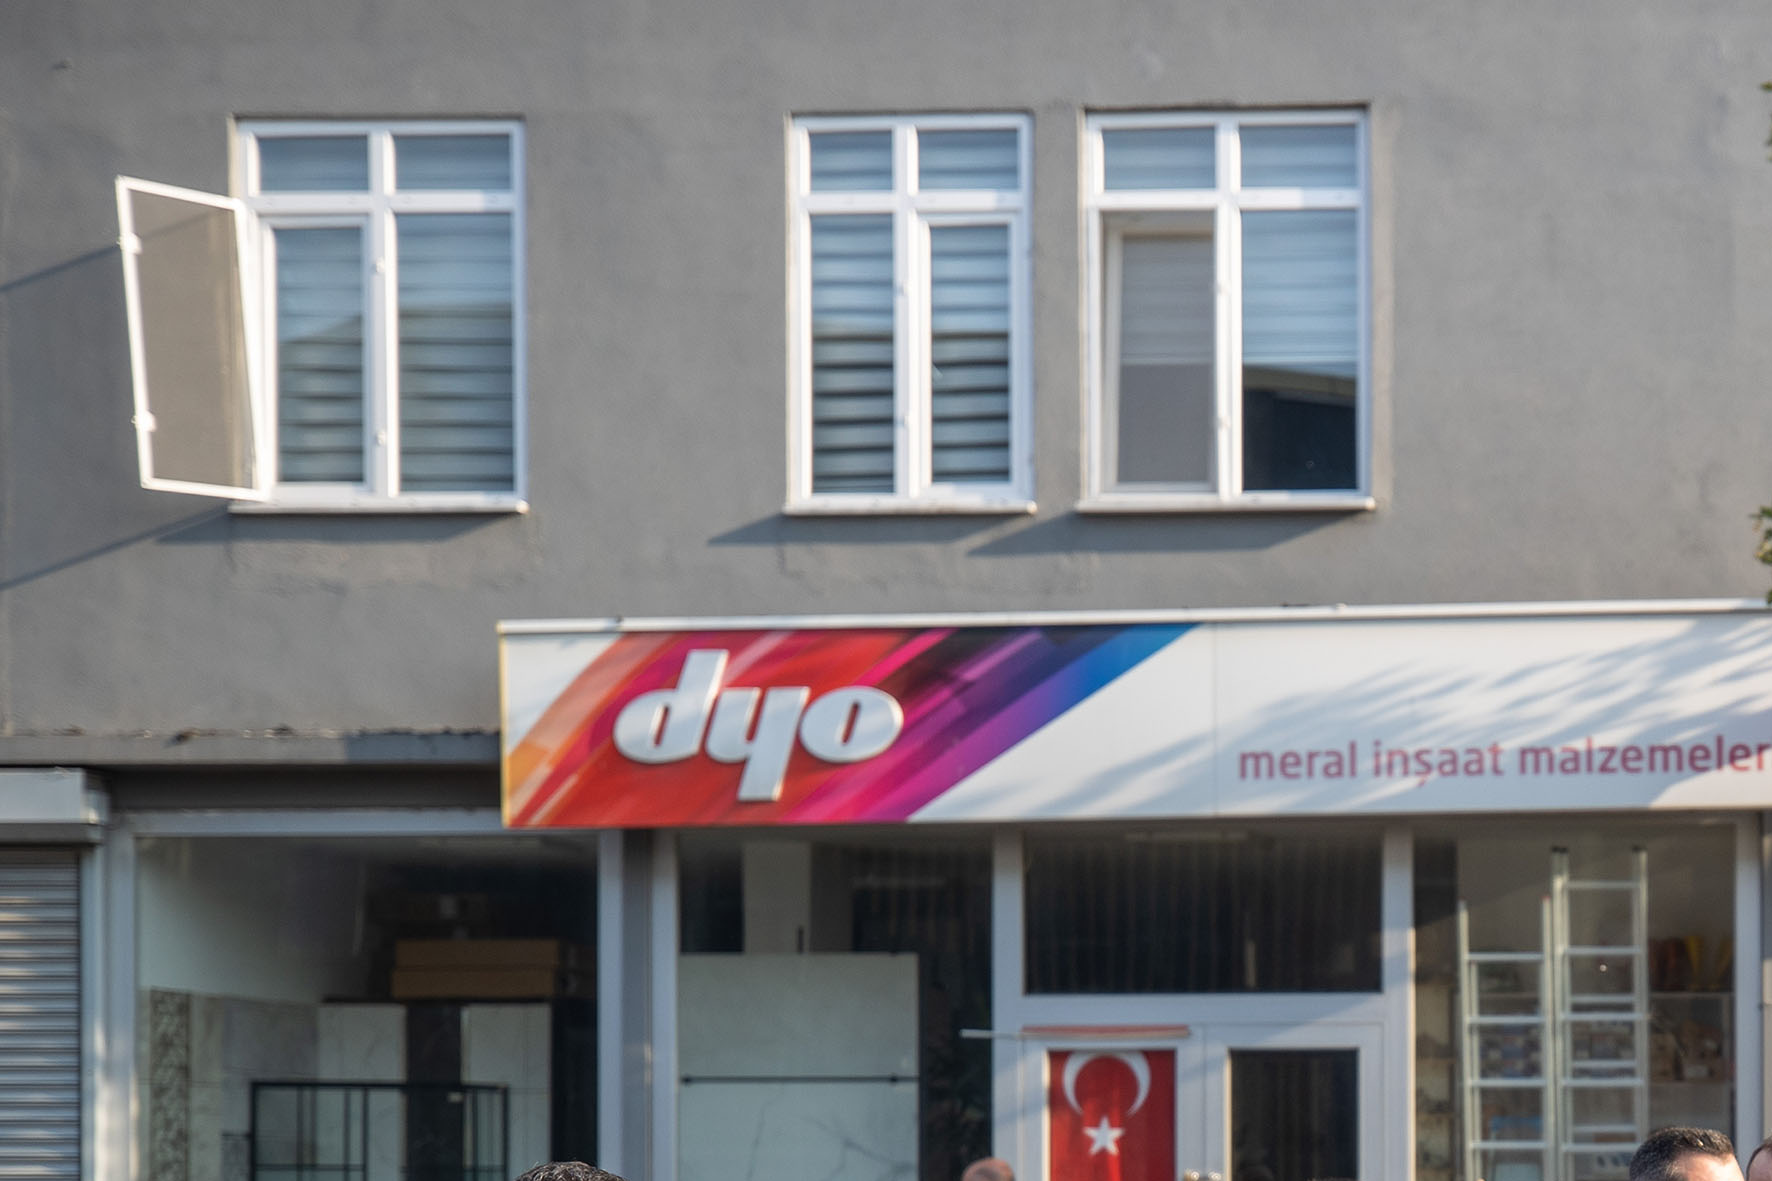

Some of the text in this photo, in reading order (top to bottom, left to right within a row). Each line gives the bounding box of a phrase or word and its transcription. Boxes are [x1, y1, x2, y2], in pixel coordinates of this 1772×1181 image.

[613, 648, 904, 803] dyo
[1239, 742, 1357, 780] meral
[1372, 740, 1504, 788] inşaat
